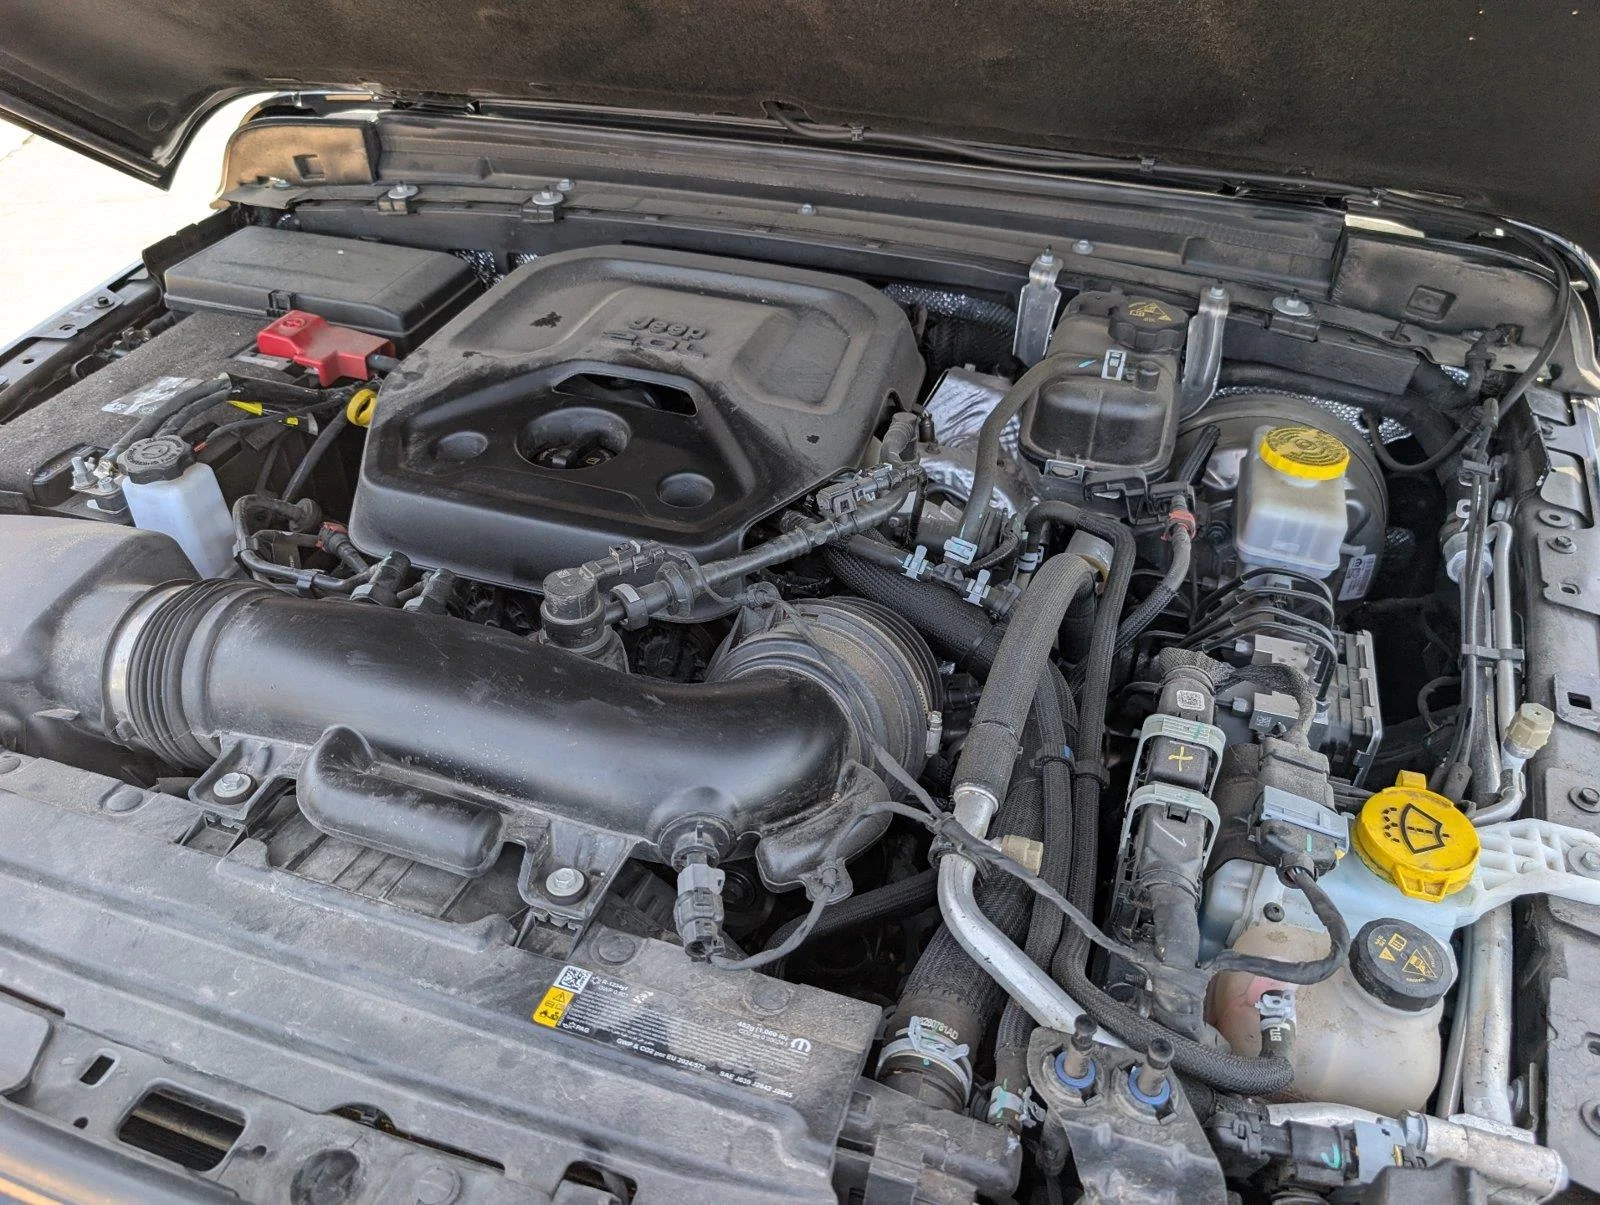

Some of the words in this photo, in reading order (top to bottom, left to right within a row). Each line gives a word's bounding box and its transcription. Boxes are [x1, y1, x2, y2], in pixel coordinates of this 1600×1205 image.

[627, 317, 708, 342] Jeep
[575, 1023, 590, 1034] PAG
[615, 1037, 634, 1047] GWP
[639, 1045, 655, 1055] CO2
[666, 1053, 677, 1062] EU
[719, 1070, 735, 1080] SAE
